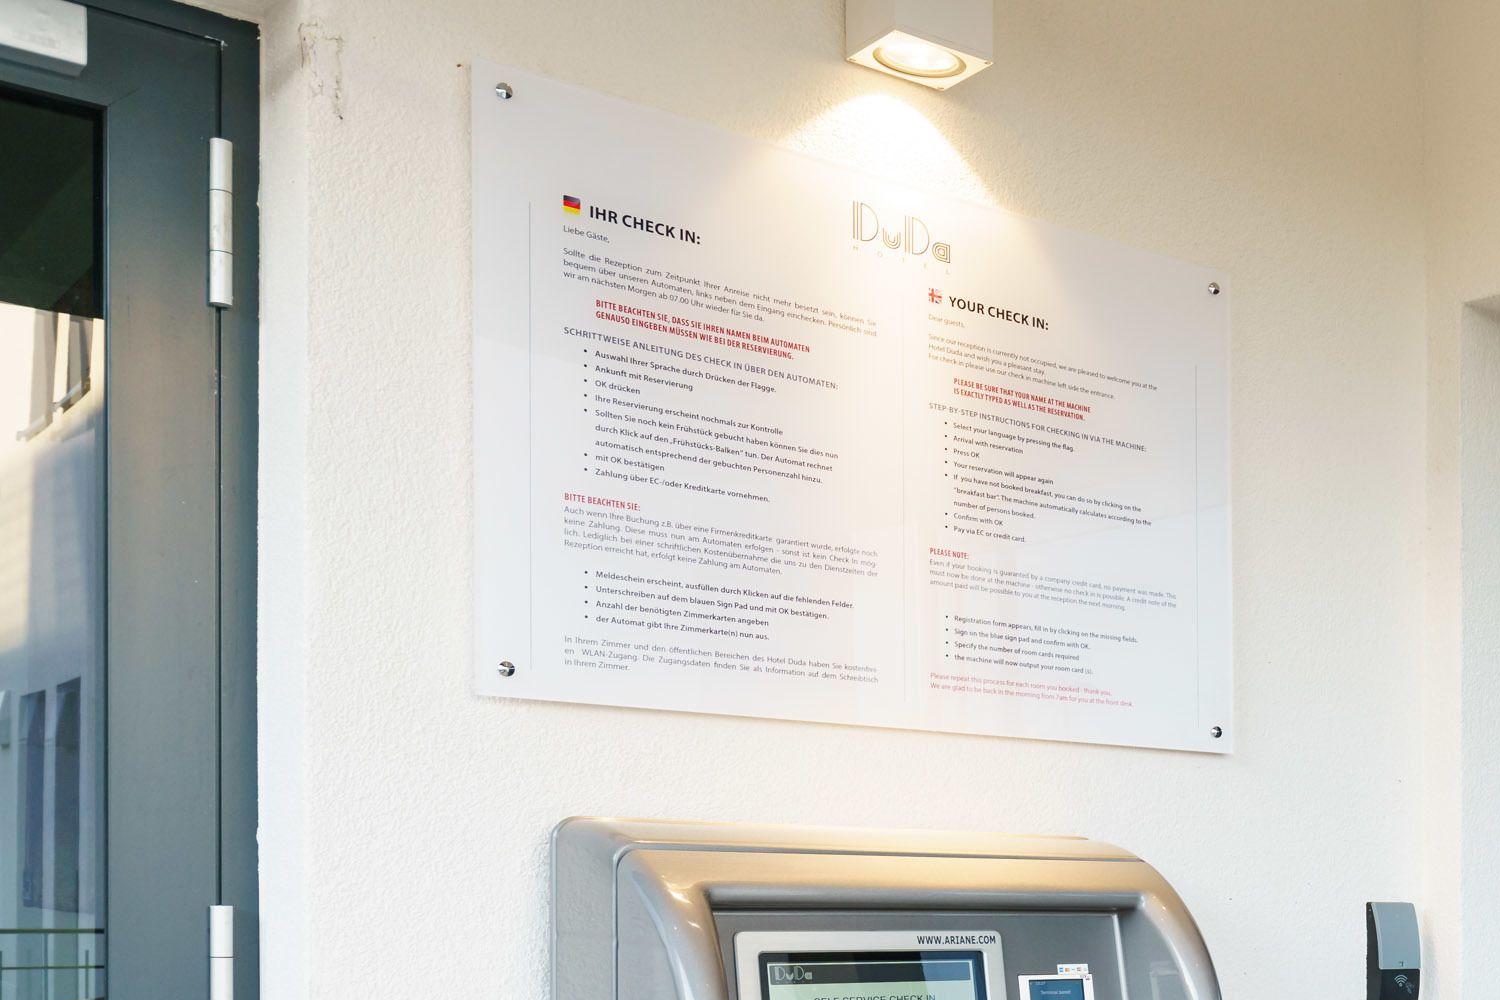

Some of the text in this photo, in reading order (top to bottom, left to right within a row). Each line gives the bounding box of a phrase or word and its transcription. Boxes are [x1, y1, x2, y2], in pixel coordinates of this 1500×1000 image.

[563, 224, 585, 237] Liebe
[589, 205, 701, 245] IHR CHECK IN:
[852, 200, 951, 264] DuDa
[595, 299, 810, 353] BITTE BEACHTEN SIE, DASS SIE IHREN NAMEN BEIM AUTOMATEN
[949, 295, 1049, 331] YOUR CHECK IN:
[595, 310, 792, 360] GENAUSO EINGEBEN MÜSSEN WIE BEI DER RESERVIERUNG.
[563, 326, 836, 390] SCHRITTWEISE ANLEITUNG DES CHECK IN ÜBER DEN AUTOMATEN:
[594, 350, 629, 364] Auswahl
[629, 356, 649, 368] Ihrer
[649, 361, 681, 374] Sprache
[681, 367, 704, 379] durch
[704, 372, 736, 385] Drücken
[736, 378, 750, 388] der
[594, 379, 641, 395] OK drücken
[595, 364, 694, 393] Ankunft mit Reservierung
[953, 377, 975, 389] PLEASE
[983, 384, 999, 394] SURE
[1014, 390, 1031, 401] YOUR
[1030, 394, 1047, 404] NAME
[1066, 401, 1091, 414] MACHINE
[594, 394, 784, 436] Ihre Reservierung erscheint nochmals zur Kontrolle
[960, 388, 985, 400] EXACTLY
[984, 393, 1004, 404] TYPED
[1011, 399, 1027, 410] WELL
[594, 409, 839, 460] Sollten Sie noch kein Frühstück gebucht haben können Sie dies nun
[928, 402, 979, 418] STEP-BY-STEP
[979, 412, 1031, 429] INSTRUCTIONS
[1031, 422, 1046, 432] FOR
[1046, 426, 1081, 439] CHECKING
[1081, 433, 1089, 441] IN
[1089, 434, 1101, 444] VIA
[1101, 437, 1115, 446] THE
[595, 454, 665, 472] mit OK bestätigen
[595, 467, 629, 482] Zahlung
[629, 473, 648, 484] über
[649, 476, 683, 489] EC-/oder
[683, 482, 726, 496] Kreditkarte
[564, 492, 641, 511] BITTE BEACHTEN SIE:
[929, 547, 952, 558] PLEASE
[595, 570, 645, 584] Meldeschein
[684, 583, 719, 593] ausfüllen
[720, 586, 742, 596] durch
[742, 588, 769, 599] Klicken
[770, 593, 782, 601] auf
[782, 594, 795, 602] die
[795, 595, 831, 607] fehlenden
[595, 600, 770, 627] Anzahl der benötigten Zimmerkarten angeben
[595, 615, 610, 624] der
[610, 616, 645, 627] Automat
[646, 620, 663, 630] gibt
[663, 622, 679, 631] Ihre
[680, 623, 739, 638] Zimmerkarte(n)
[917, 935, 996, 945] WWW.ARIANE.COM
